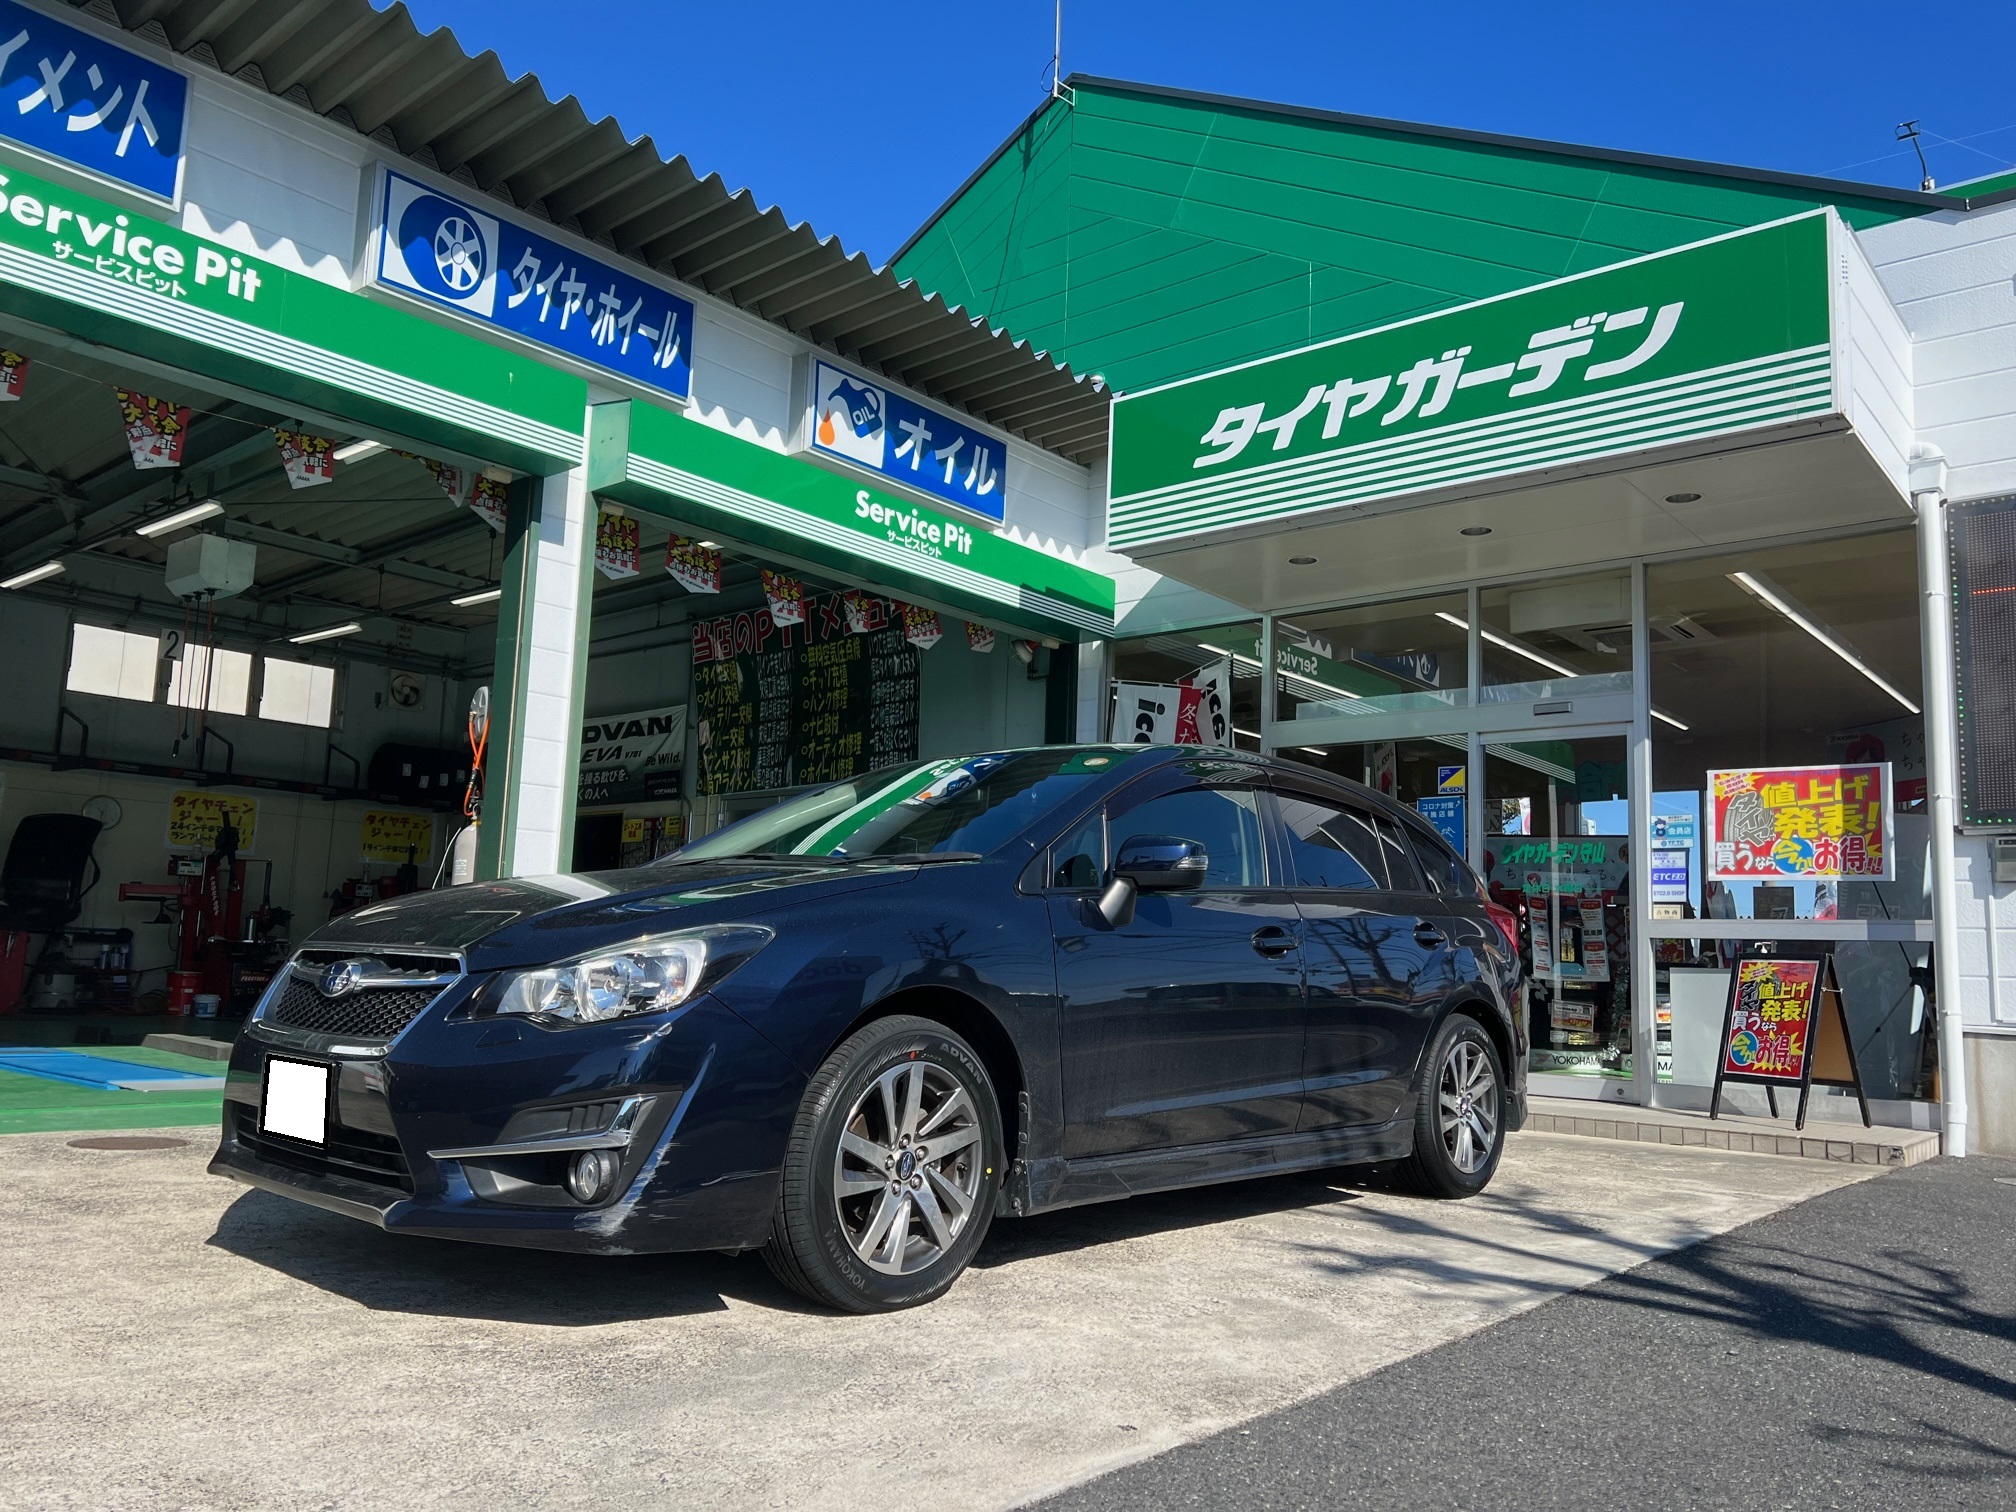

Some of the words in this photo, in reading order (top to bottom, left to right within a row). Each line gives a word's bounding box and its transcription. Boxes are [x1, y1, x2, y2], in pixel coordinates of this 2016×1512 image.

[53, 240, 188, 298] サービスピット
[194, 246, 261, 302] Pit
[508, 246, 681, 370] タイヤ・ホイール
[1194, 301, 1685, 468] タイヤガーデン
[852, 407, 876, 426] OIL
[894, 418, 997, 495] オイル
[855, 490, 941, 543] Service
[944, 521, 973, 556] Pit
[887, 529, 943, 559] サービスピット
[165, 630, 180, 659] 2
[1440, 787, 1464, 797] ALSOK
[1759, 775, 1870, 809] 値上げ
[1668, 826, 1692, 836] 会員店
[1773, 801, 1881, 841] 発表!
[1501, 841, 1606, 865] タイヤガーデン守山
[1716, 840, 1777, 872] 買うなら
[1653, 873, 1671, 881] ETC
[1758, 982, 1809, 1001] 値上げ
[1732, 1010, 1778, 1032] 買うなら
[1760, 999, 1810, 1023] 発表!
[939, 1043, 984, 1085] ADVAN
[825, 1230, 867, 1291] YOKOHAMA
